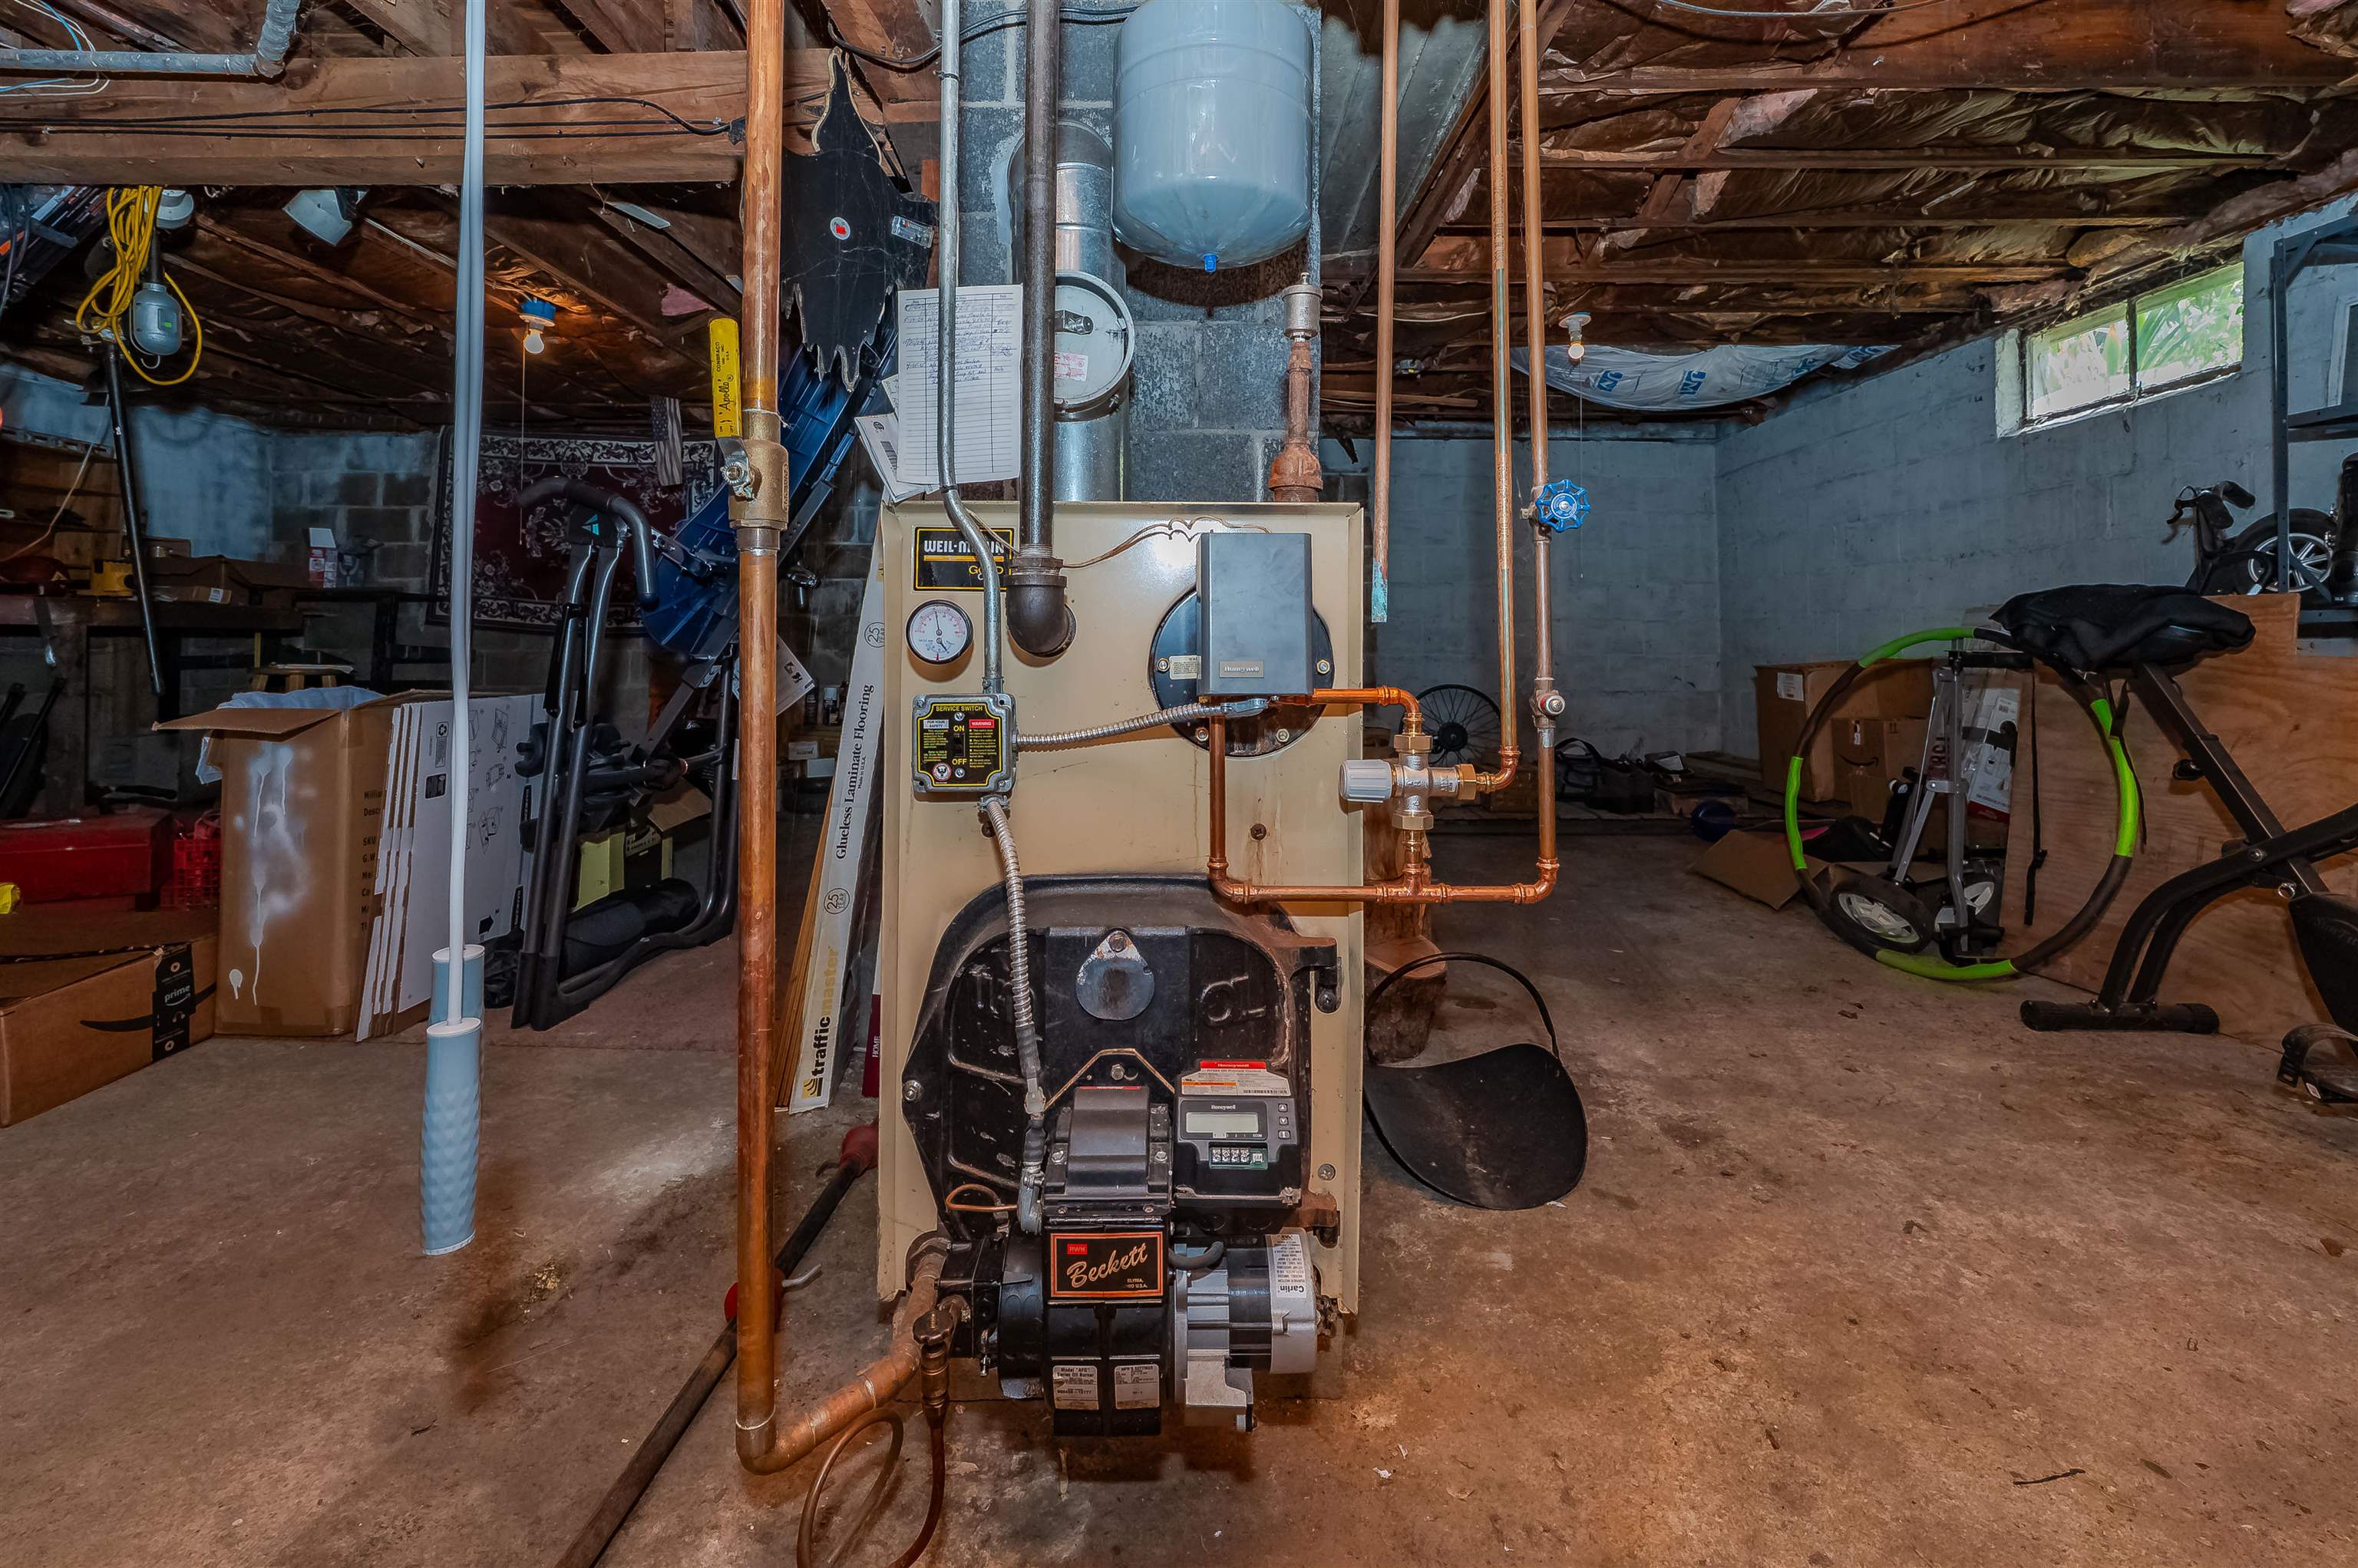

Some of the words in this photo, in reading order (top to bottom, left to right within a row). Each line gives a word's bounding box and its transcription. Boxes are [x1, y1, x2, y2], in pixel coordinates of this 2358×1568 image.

[969, 565, 1004, 575] GD
[867, 626, 880, 643] 25
[835, 806, 853, 860] Glueless
[844, 743, 863, 804] Laminate
[854, 684, 875, 741] Flooring
[362, 837, 376, 847] SKU
[827, 894, 839, 910] 25
[164, 985, 191, 1003] prime
[1066, 1242, 1148, 1289] Beckett
[1280, 1285, 1305, 1293] Carlin
